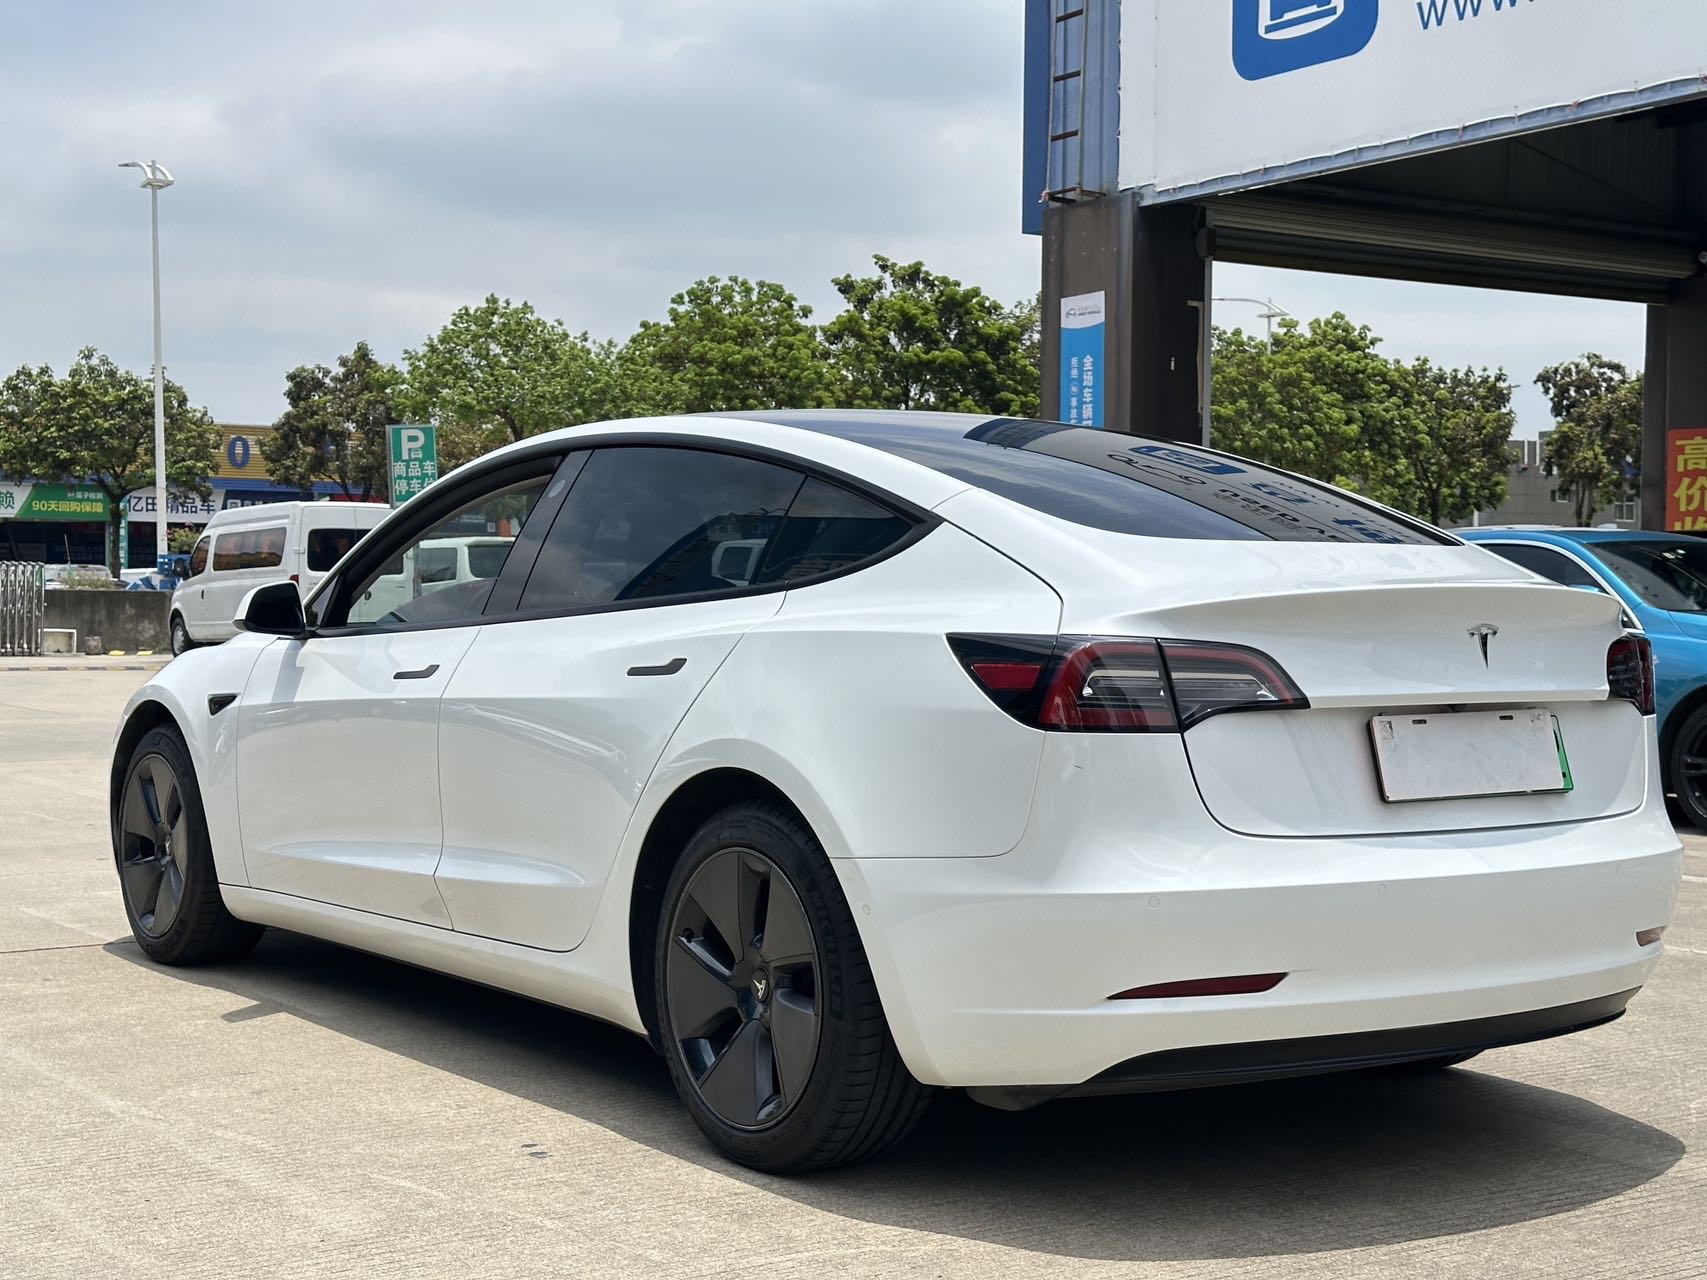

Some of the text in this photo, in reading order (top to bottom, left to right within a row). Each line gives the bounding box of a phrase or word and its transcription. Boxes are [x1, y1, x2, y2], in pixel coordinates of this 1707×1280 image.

[401, 428, 425, 460] P
[393, 461, 435, 477] 商品车
[1673, 436, 1707, 531] 高价
[32, 500, 103, 512] 90天回购保障
